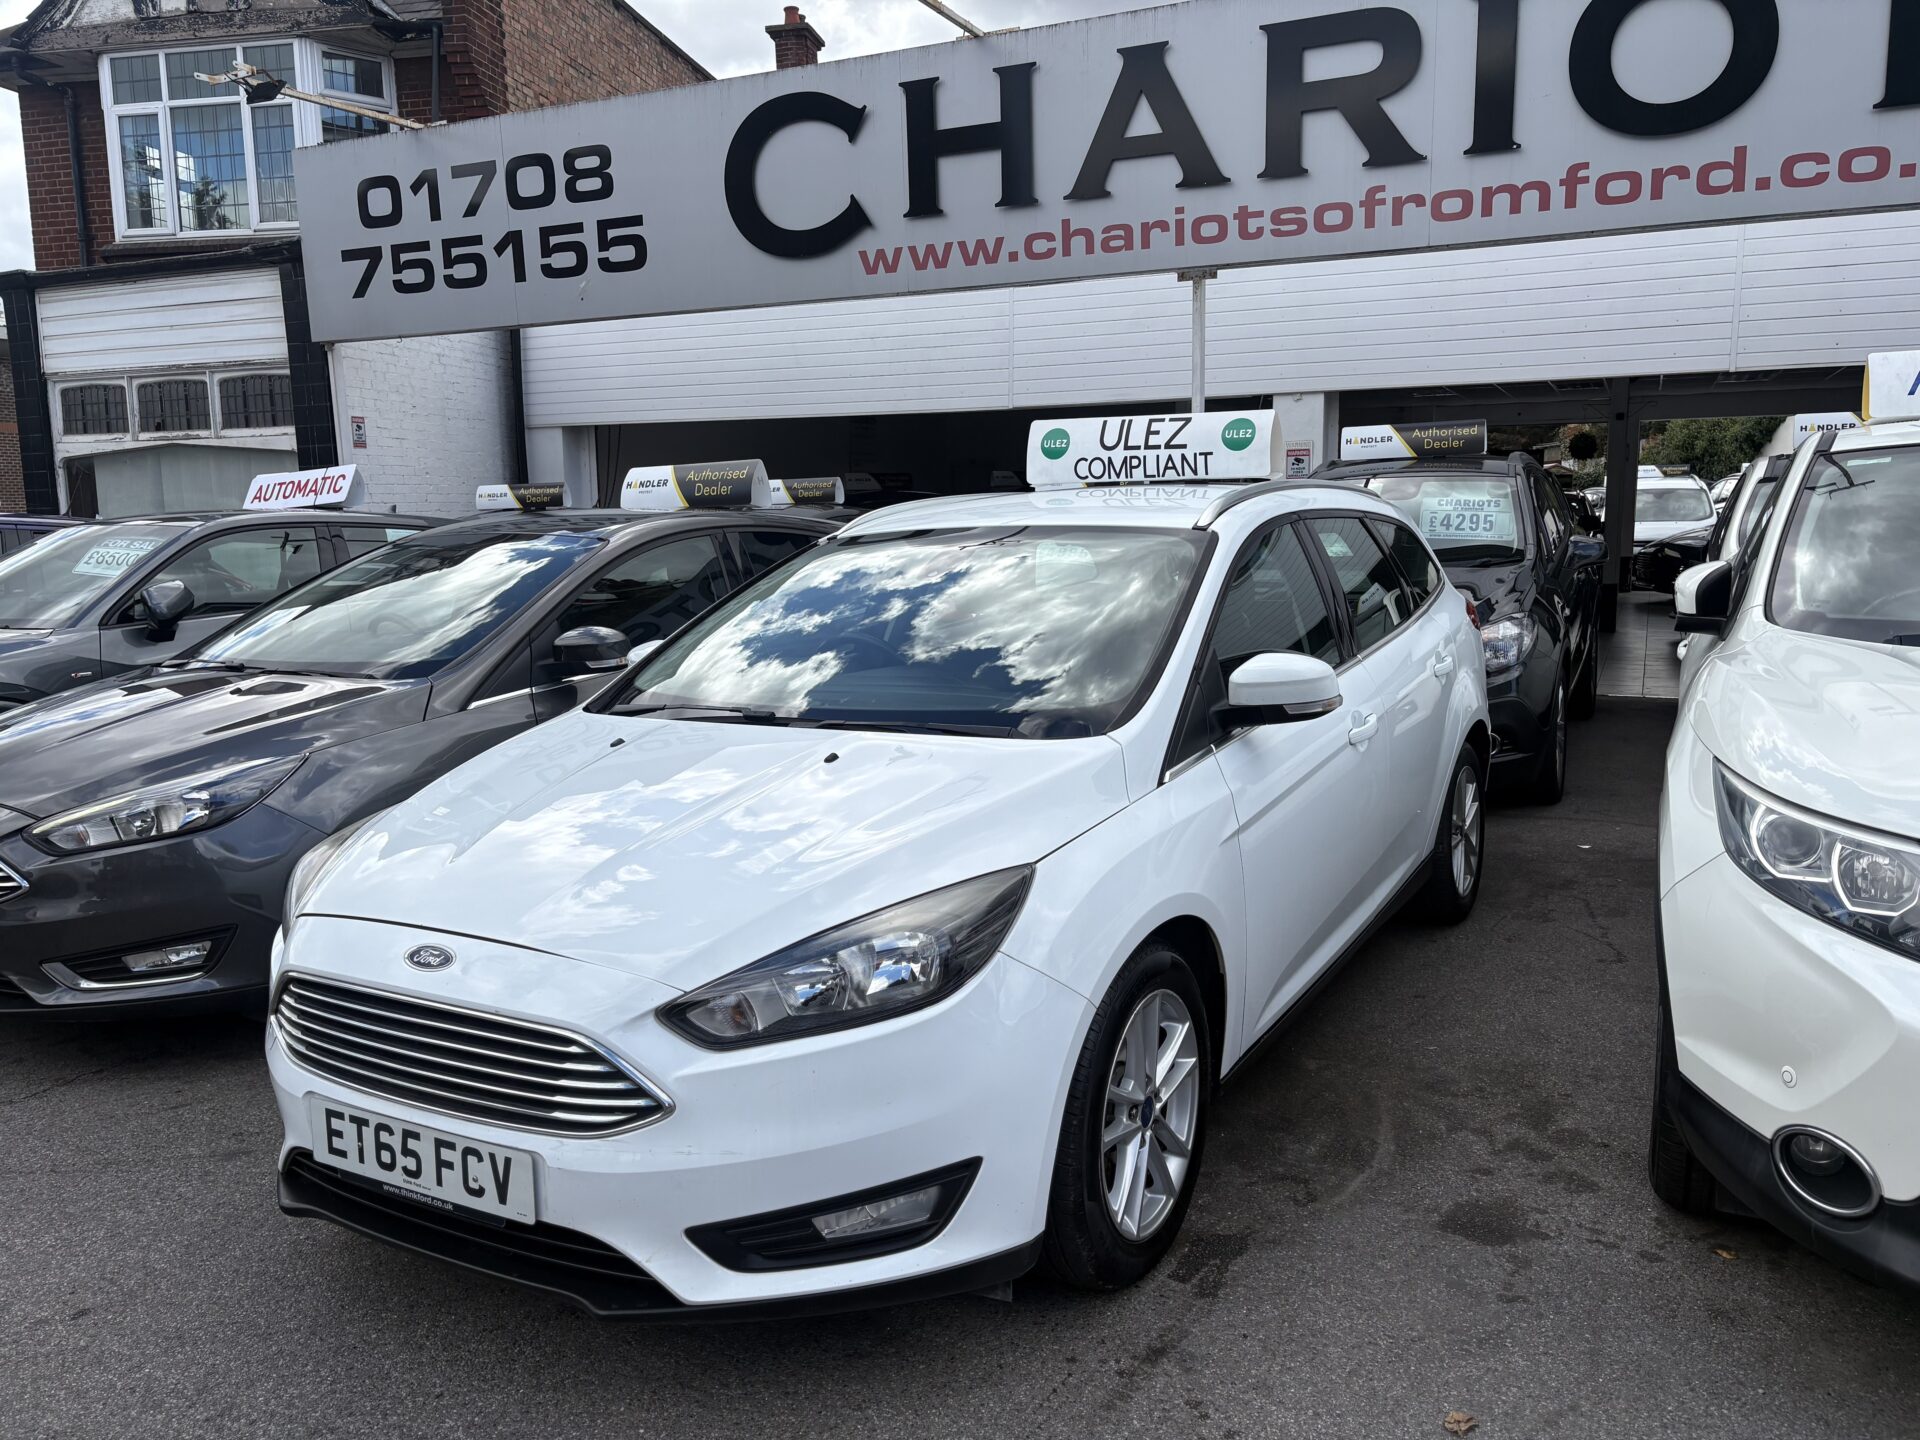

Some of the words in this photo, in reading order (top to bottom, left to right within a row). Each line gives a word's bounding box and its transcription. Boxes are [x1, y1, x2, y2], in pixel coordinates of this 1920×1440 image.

[357, 144, 614, 229] 01708
[340, 214, 648, 300] 755155
[1100, 417, 1193, 452] ULEZ
[1225, 429, 1253, 439] ULEZ
[1412, 425, 1479, 438] Authorised
[1044, 439, 1068, 448] ULEZ
[1345, 436, 1394, 445] HANDLER
[1424, 439, 1465, 449] Dealer
[1074, 452, 1213, 480] COMPLIANT
[686, 466, 750, 481] Authorised
[250, 473, 346, 504] AUTOMATIC
[519, 486, 559, 495] Authorised
[626, 479, 669, 490] HANDLER
[695, 481, 732, 496] Dealer
[792, 481, 832, 490] Authorised
[526, 495, 551, 503] Dealer
[1437, 499, 1501, 507] CHARIOTS
[1428, 512, 1494, 532] £4295
[103, 540, 130, 548] FOR
[130, 541, 158, 549] SAL
[414, 949, 445, 965] Ford
[325, 1108, 422, 1180] ET65
[434, 1137, 512, 1205] FCV
[383, 1184, 453, 1210] www.thinkford.co.uk
